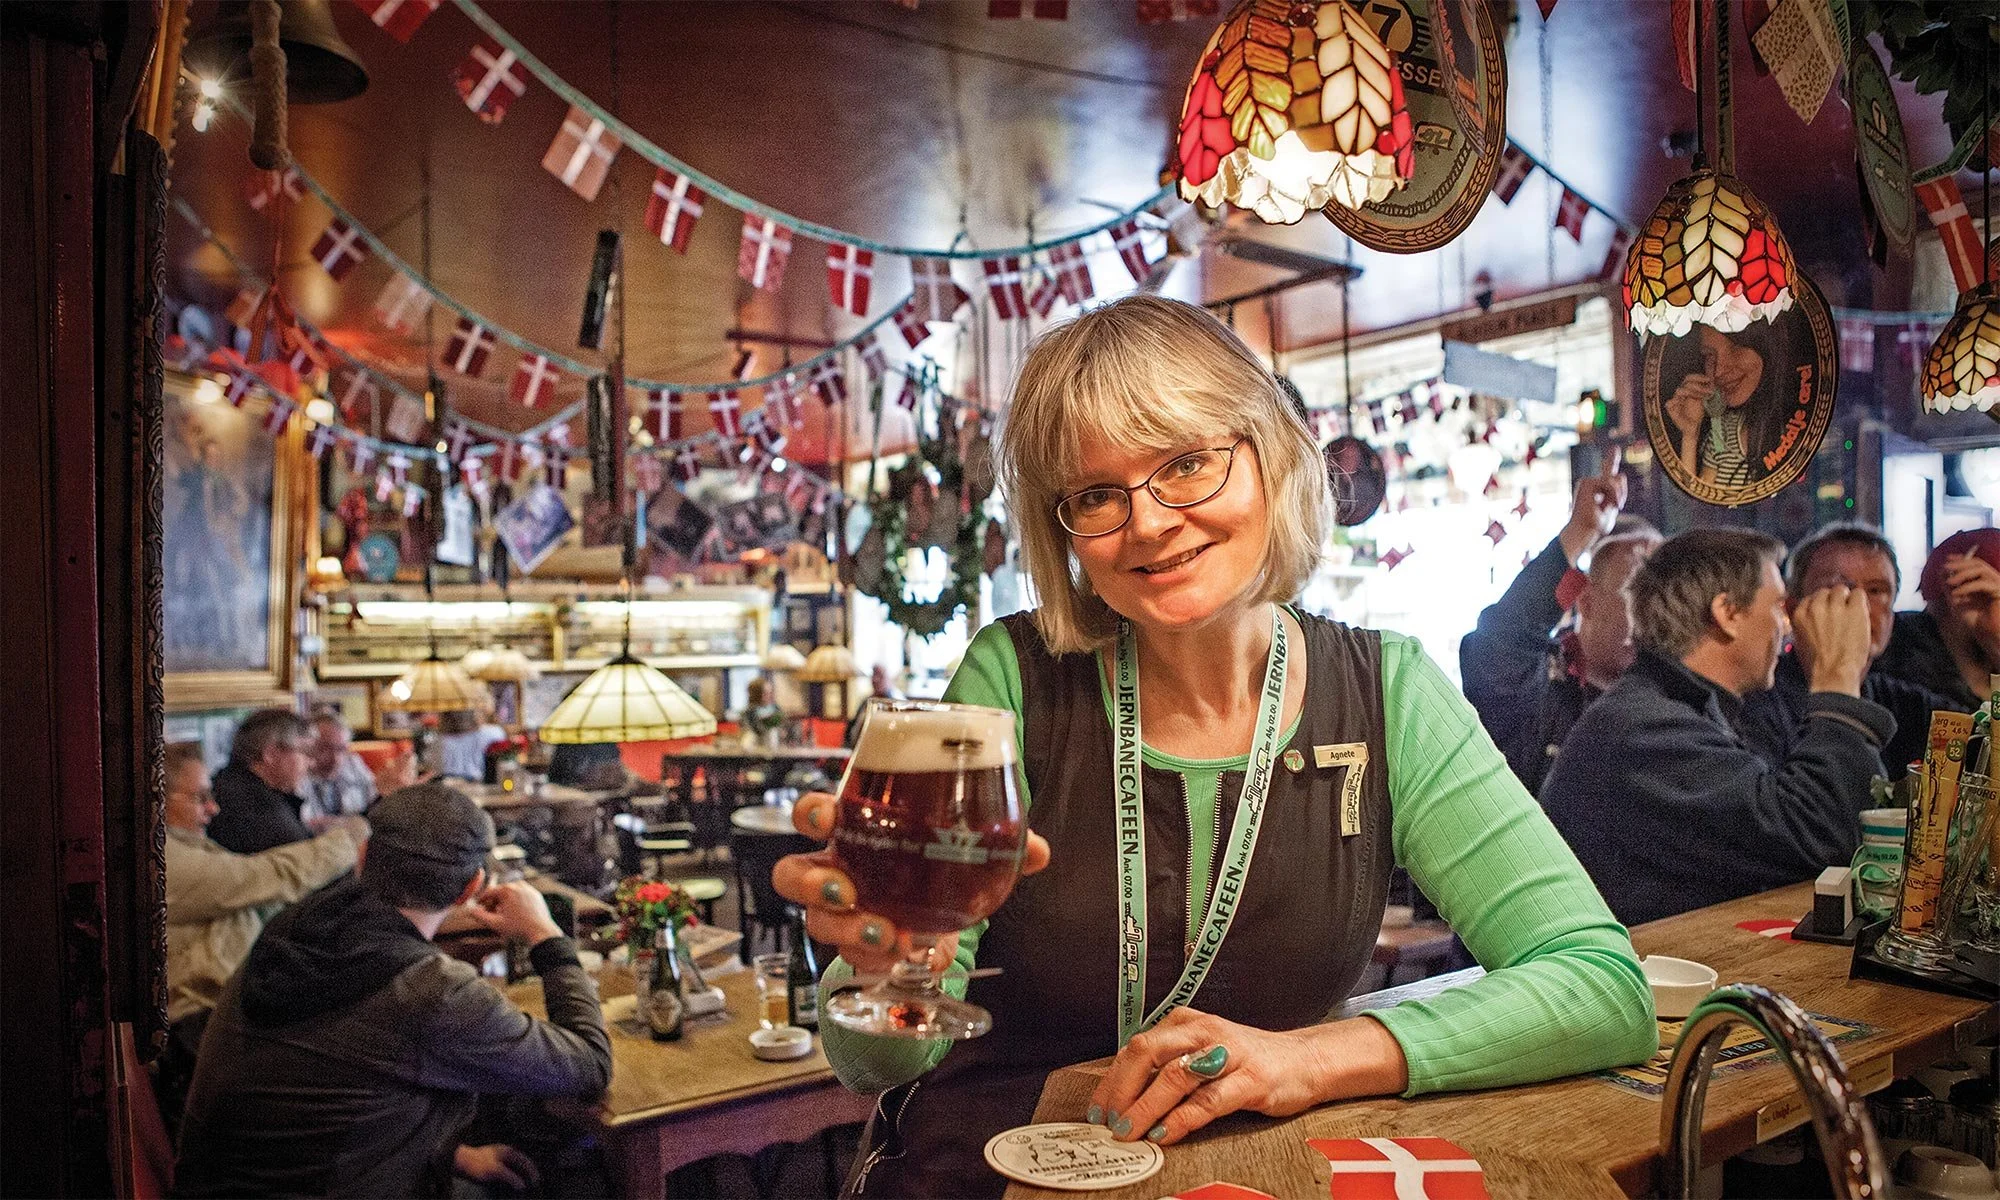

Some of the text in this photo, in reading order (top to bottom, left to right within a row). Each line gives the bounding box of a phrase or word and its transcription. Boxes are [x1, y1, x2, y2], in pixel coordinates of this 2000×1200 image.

[1371, 3, 1402, 46] 7
[1716, 0, 1730, 109] BANECAFEEN
[1397, 61, 1446, 89] SSE
[1267, 614, 1287, 702] JERNBAN
[1267, 704, 1277, 725] 02.00
[1330, 750, 1356, 761] Agnete
[1949, 747, 1961, 757] 52
[1119, 684, 1139, 855] JERNBANECAFEEN
[1241, 828, 1253, 850] 07.00
[1123, 857, 1132, 874] Ank
[1237, 851, 1248, 868] Ank
[1123, 875, 1132, 898] 07.00
